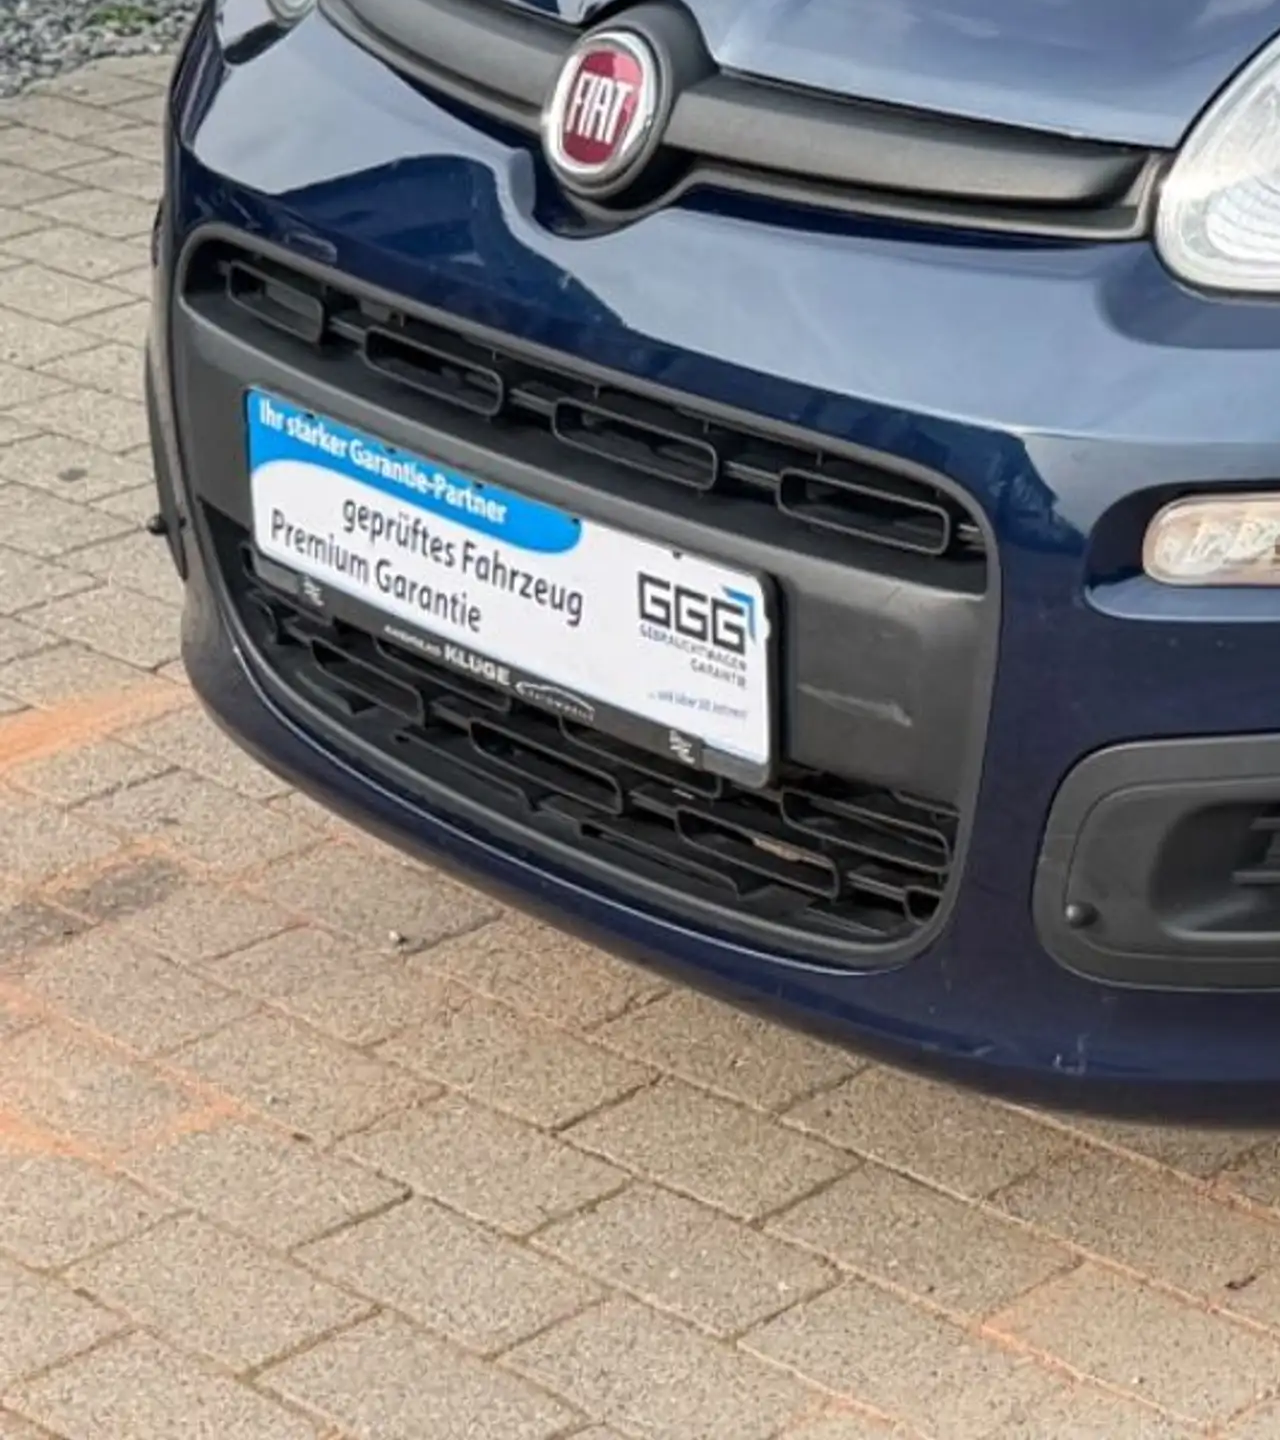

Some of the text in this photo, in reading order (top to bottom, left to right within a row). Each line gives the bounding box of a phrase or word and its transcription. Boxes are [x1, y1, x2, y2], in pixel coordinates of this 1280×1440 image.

[566, 70, 633, 145] FIAT
[259, 398, 507, 524] Ihr starker Garantie-Partner
[271, 508, 482, 632] Premium Garantie
[343, 499, 583, 628] geprüftes Fahrzeug
[637, 571, 746, 656] GGG
[443, 642, 511, 686] KLUGE
